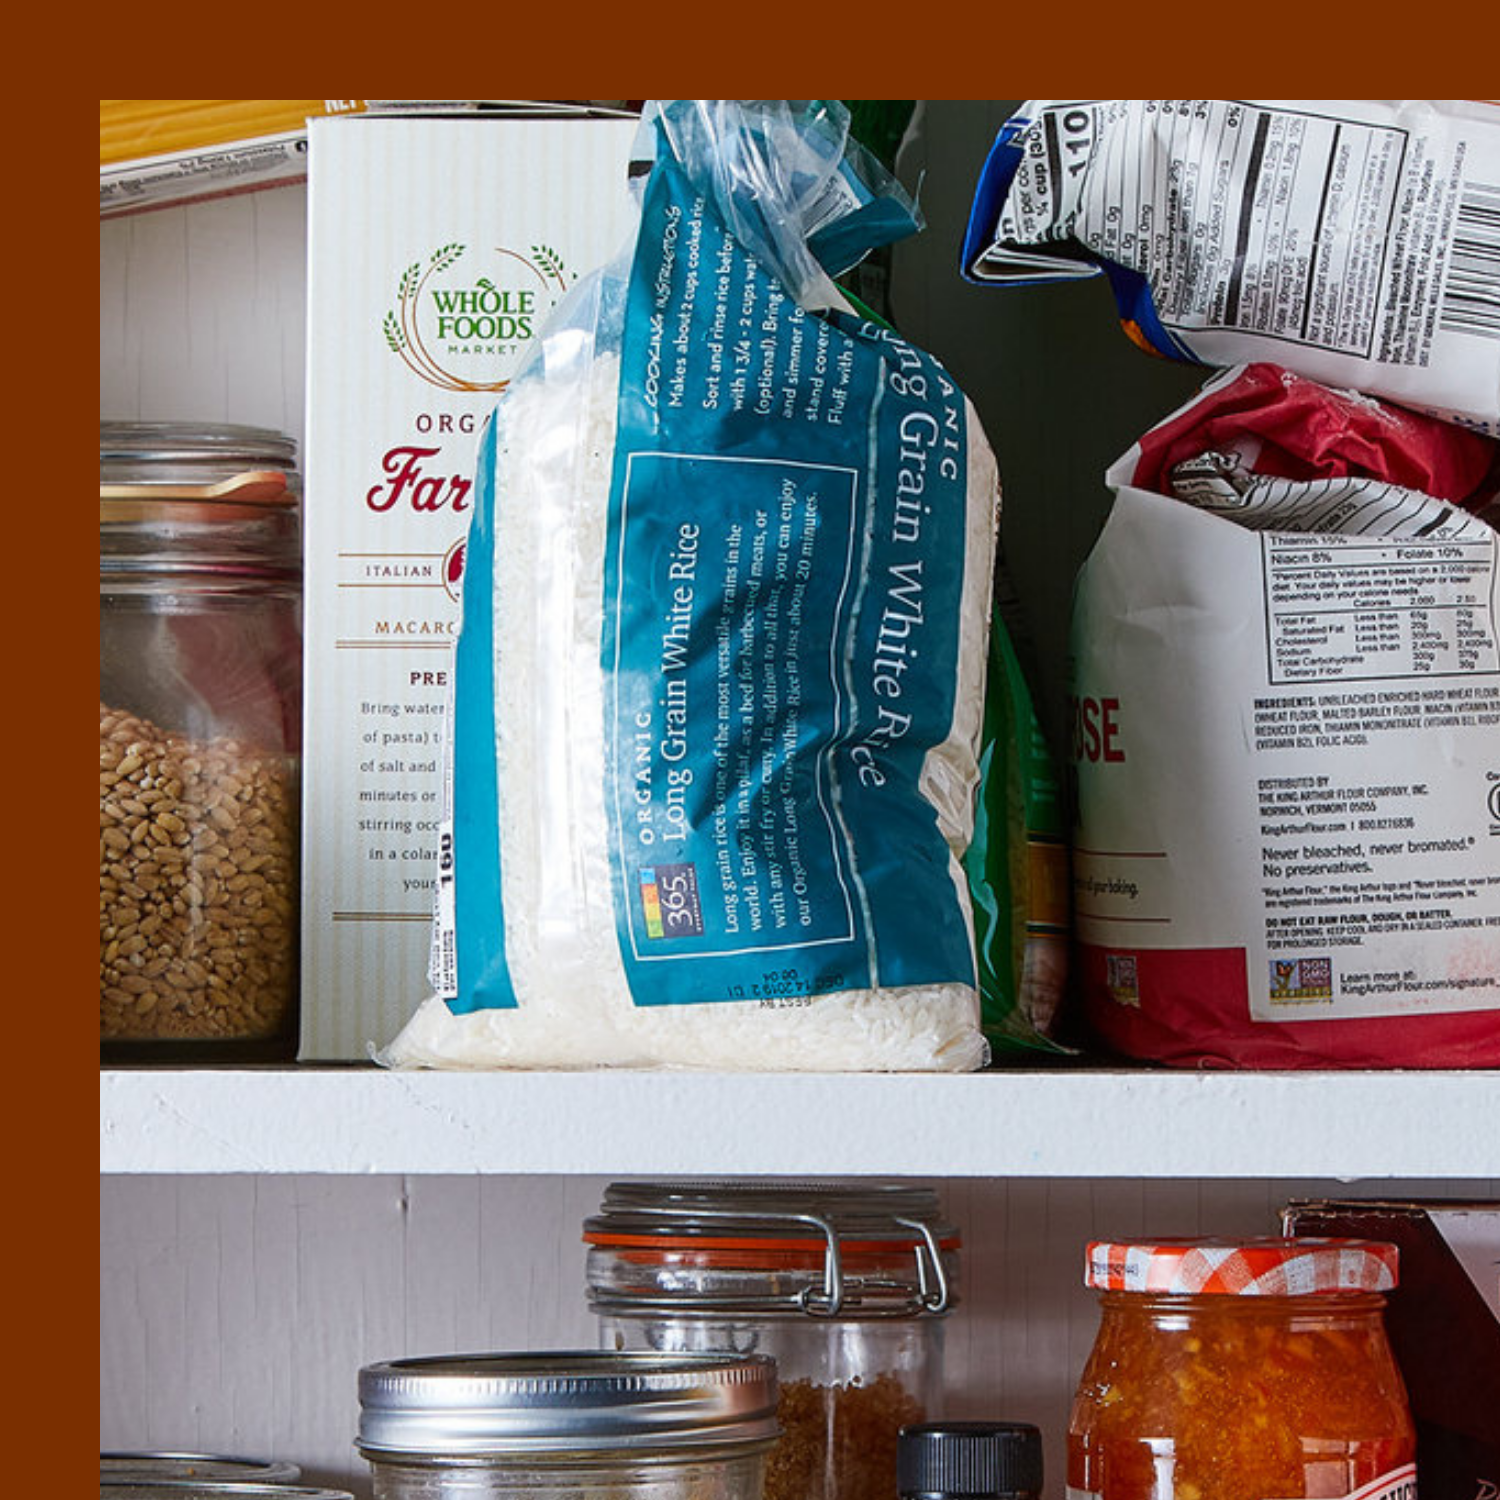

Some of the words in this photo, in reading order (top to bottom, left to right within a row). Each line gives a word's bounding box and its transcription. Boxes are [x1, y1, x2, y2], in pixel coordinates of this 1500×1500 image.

[1063, 110, 1091, 178] 110
[685, 270, 699, 296] cups
[715, 274, 730, 300] rice
[432, 290, 535, 314] WHOLE
[763, 293, 784, 332] Bring
[437, 316, 532, 339] FOODS
[673, 312, 692, 355] about
[709, 304, 727, 339] rinse
[448, 345, 518, 354] MARKET
[707, 340, 724, 372] and
[669, 358, 686, 406] Makes
[703, 376, 721, 410] Sort
[896, 412, 939, 547] Grain
[669, 523, 699, 581] Rice
[1272, 553, 1309, 564] Niacin
[366, 565, 433, 576] ITALIAN
[661, 586, 693, 673] White
[874, 558, 926, 700] White
[361, 703, 400, 717] Bring
[404, 704, 445, 715] water
[659, 679, 686, 762] Grain
[363, 730, 378, 743] of
[360, 760, 376, 772] of
[378, 760, 404, 772] salt
[408, 760, 436, 772] and
[634, 711, 655, 845] ORGANIC
[360, 791, 417, 801] minutes
[661, 768, 693, 841] Long
[358, 819, 412, 833] stirring
[714, 850, 737, 890] grain
[1262, 846, 1299, 861] Never
[1263, 864, 1281, 877] No
[724, 894, 739, 932] Long
